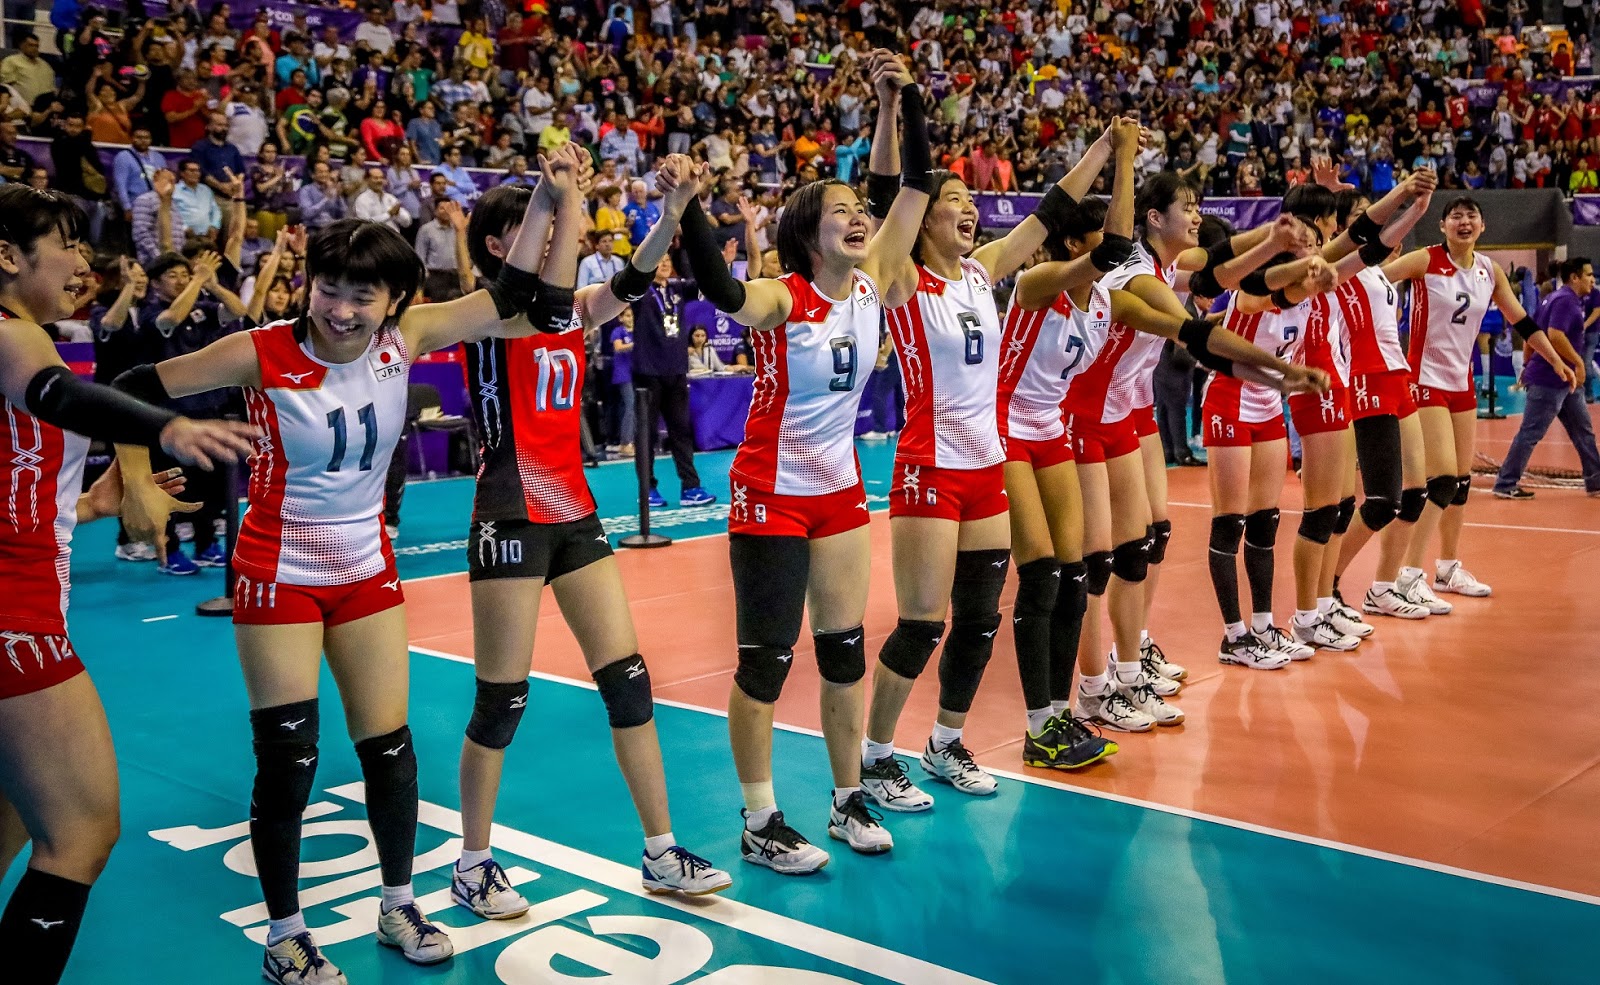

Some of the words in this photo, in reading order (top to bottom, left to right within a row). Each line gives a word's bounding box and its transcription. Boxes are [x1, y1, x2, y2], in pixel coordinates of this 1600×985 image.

[1202, 206, 1236, 216] CONADE
[862, 294, 874, 306] JPN
[1451, 291, 1471, 325] 2
[956, 311, 984, 365] 6
[828, 335, 858, 391] 9
[1060, 334, 1086, 380] 7
[381, 365, 401, 378] JPN
[533, 346, 578, 412] 10
[326, 401, 378, 472] 11
[926, 487, 937, 506] 6
[754, 503, 767, 524] 9
[500, 539, 522, 564] 10
[256, 582, 277, 609] 11
[43, 634, 73, 663] 12
